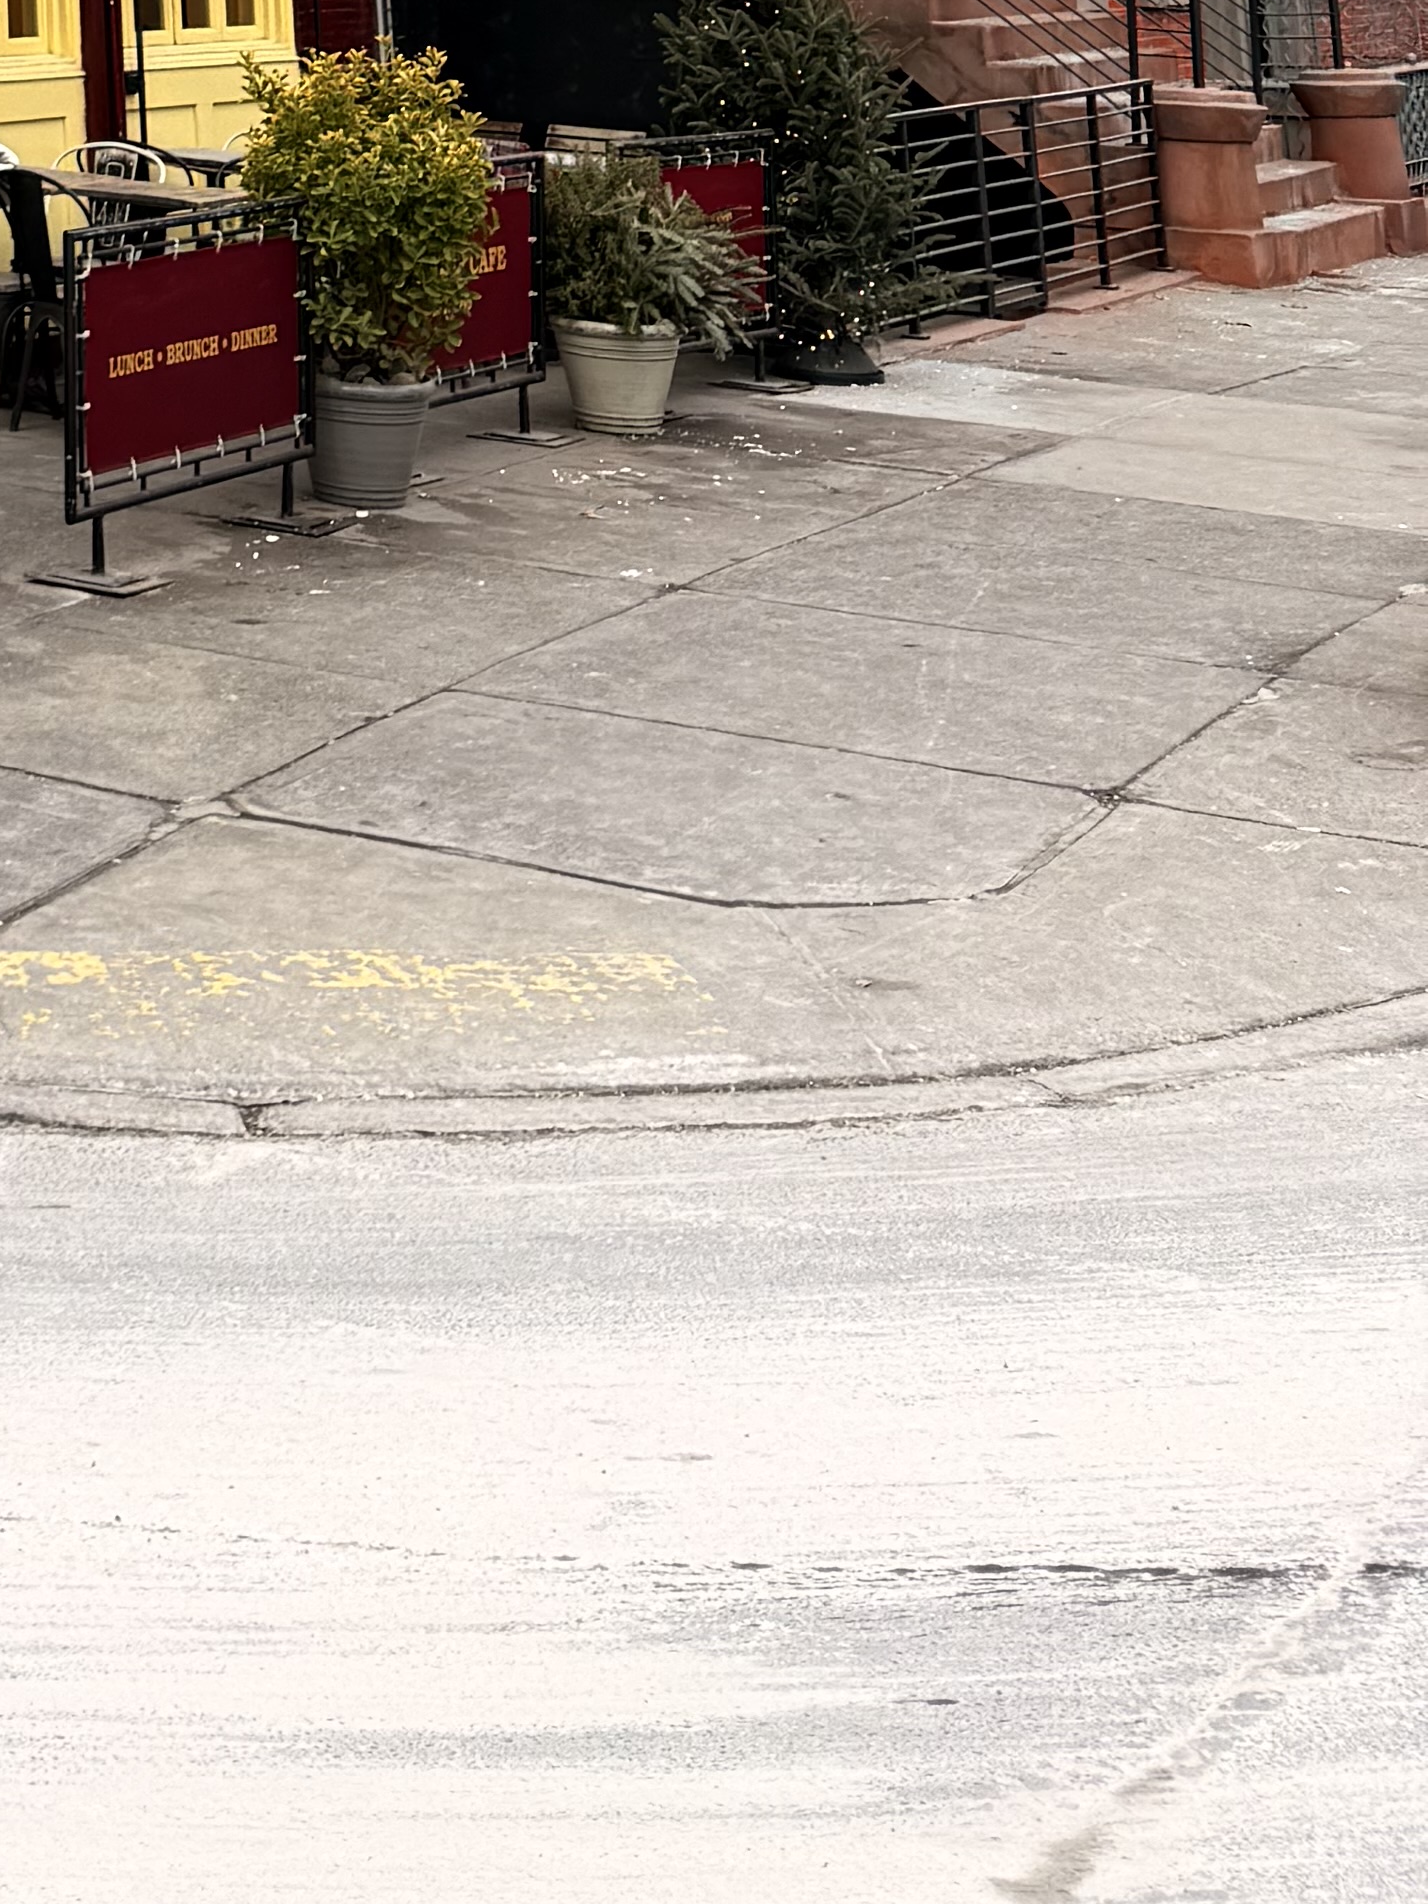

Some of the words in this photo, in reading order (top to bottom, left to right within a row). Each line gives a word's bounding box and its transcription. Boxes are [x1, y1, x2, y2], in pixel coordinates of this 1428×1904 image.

[108, 348, 155, 379] LUNCH
[166, 335, 220, 365] BRUNCH
[230, 324, 278, 352] DINNER
